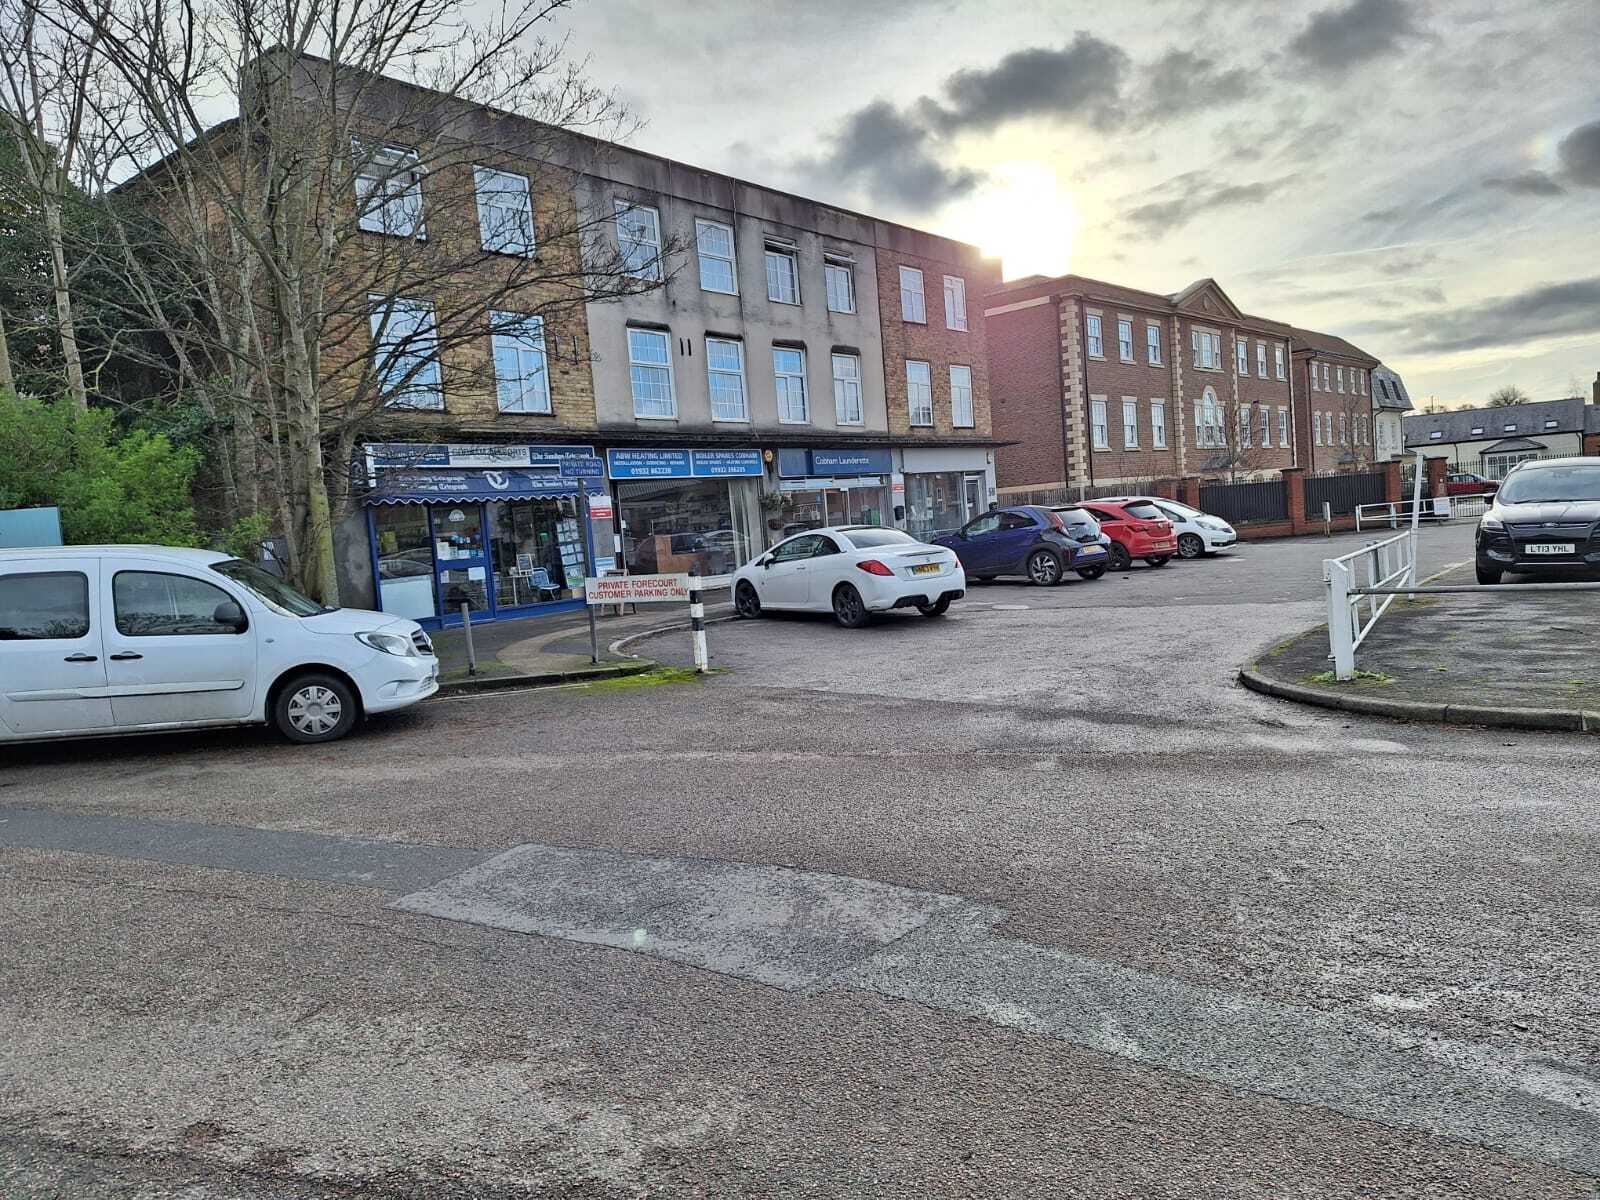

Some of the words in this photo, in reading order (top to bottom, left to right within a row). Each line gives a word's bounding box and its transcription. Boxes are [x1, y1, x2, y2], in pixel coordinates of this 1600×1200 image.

[815, 456, 838, 464] Cobham
[1530, 545, 1550, 553] LT13
[1552, 545, 1569, 553] YHL
[598, 580, 629, 590] PRIVATE
[631, 578, 677, 589] FORECOURT
[588, 590, 632, 600] CUSTOMER
[634, 588, 668, 598] PARKING
[670, 587, 689, 597] ONLY
